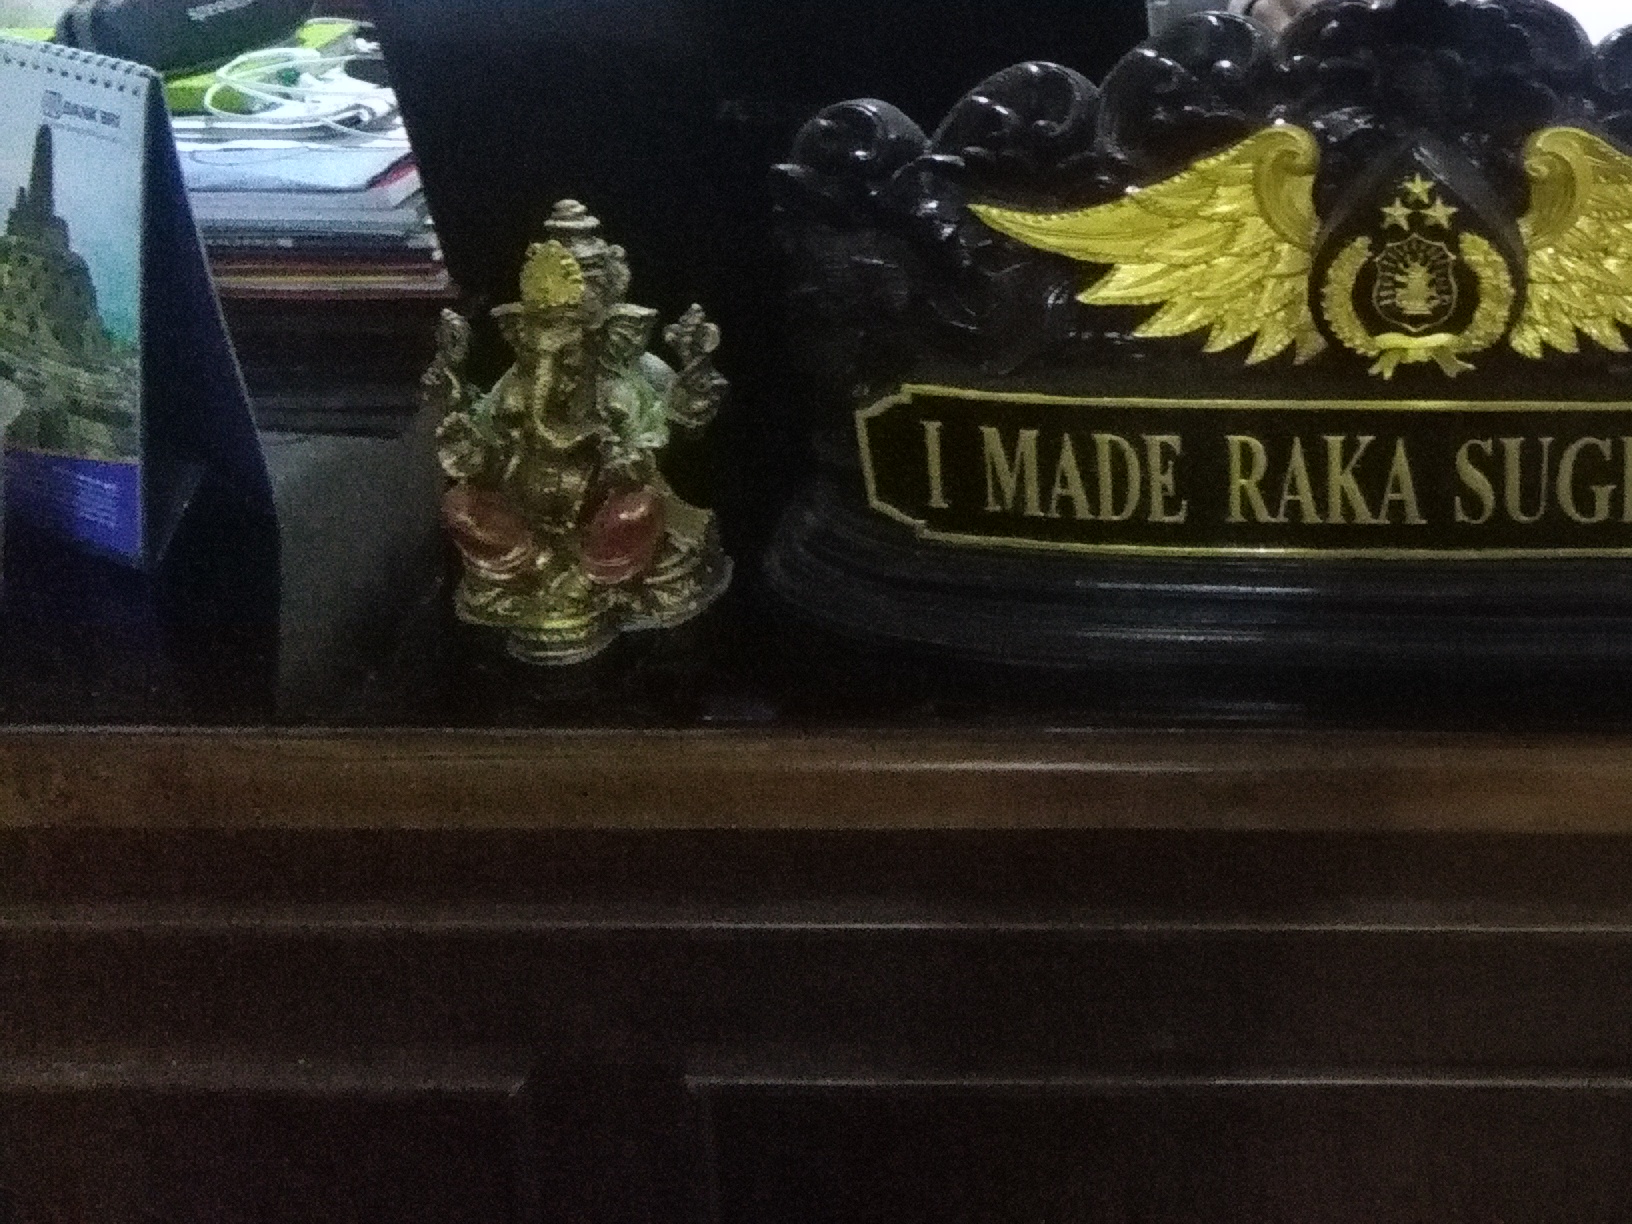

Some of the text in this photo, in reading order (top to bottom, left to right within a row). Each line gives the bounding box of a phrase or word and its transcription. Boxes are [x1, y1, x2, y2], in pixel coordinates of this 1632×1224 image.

[920, 419, 949, 509] I
[979, 425, 1189, 524] MADE
[1224, 434, 1428, 525] RAKA
